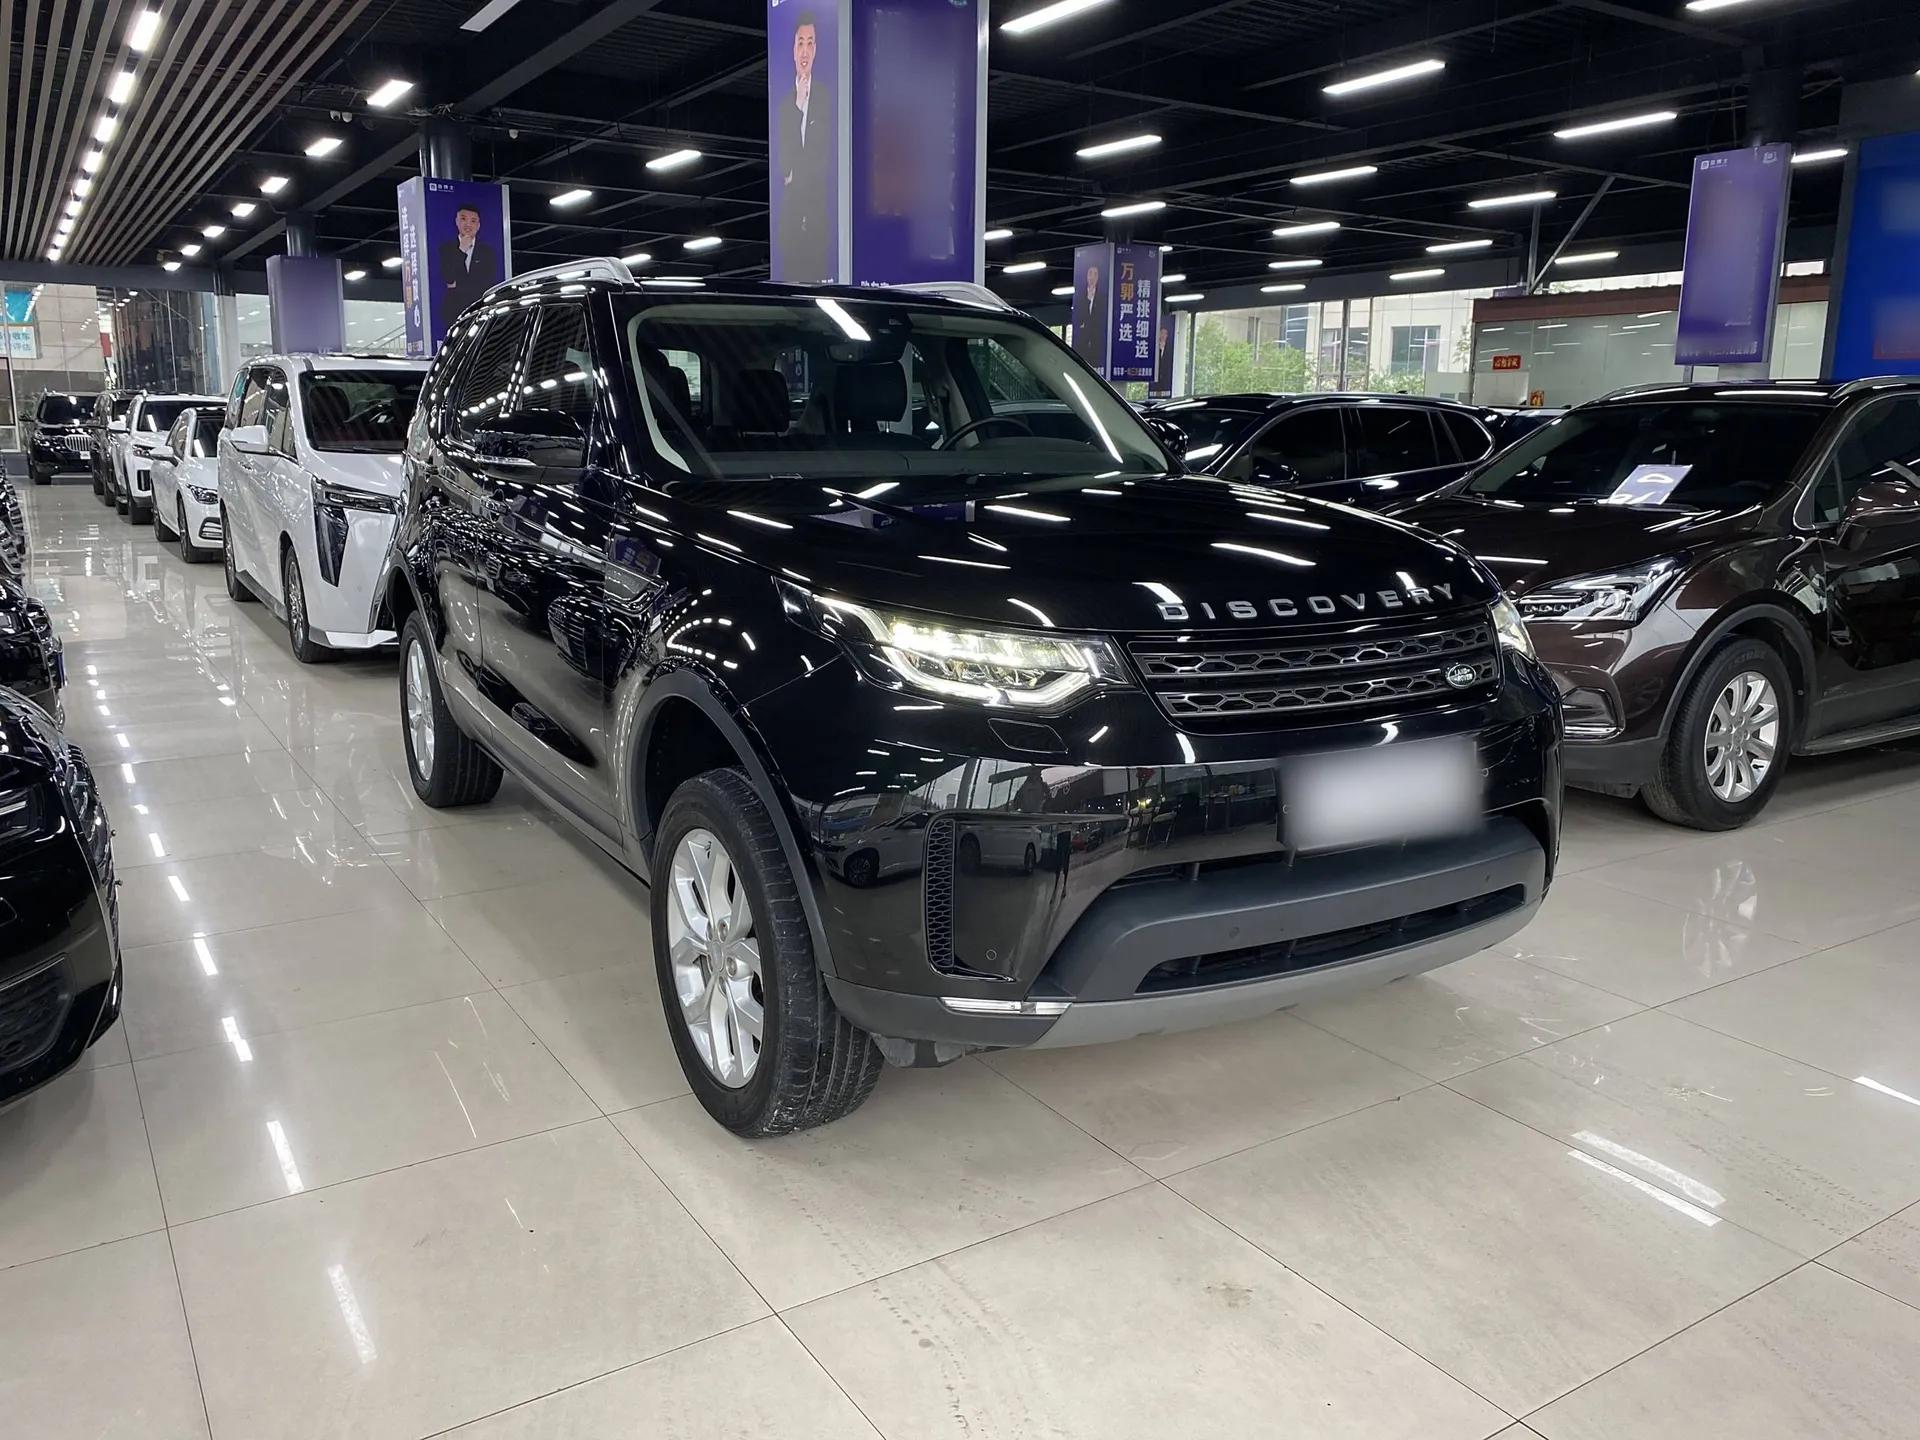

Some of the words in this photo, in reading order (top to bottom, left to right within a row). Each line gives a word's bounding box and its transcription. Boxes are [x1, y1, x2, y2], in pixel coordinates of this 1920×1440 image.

[1119, 262, 1134, 342] 万郭严选
[1135, 279, 1151, 358] 精挑细选
[1156, 583, 1453, 621] DISCOVERY
